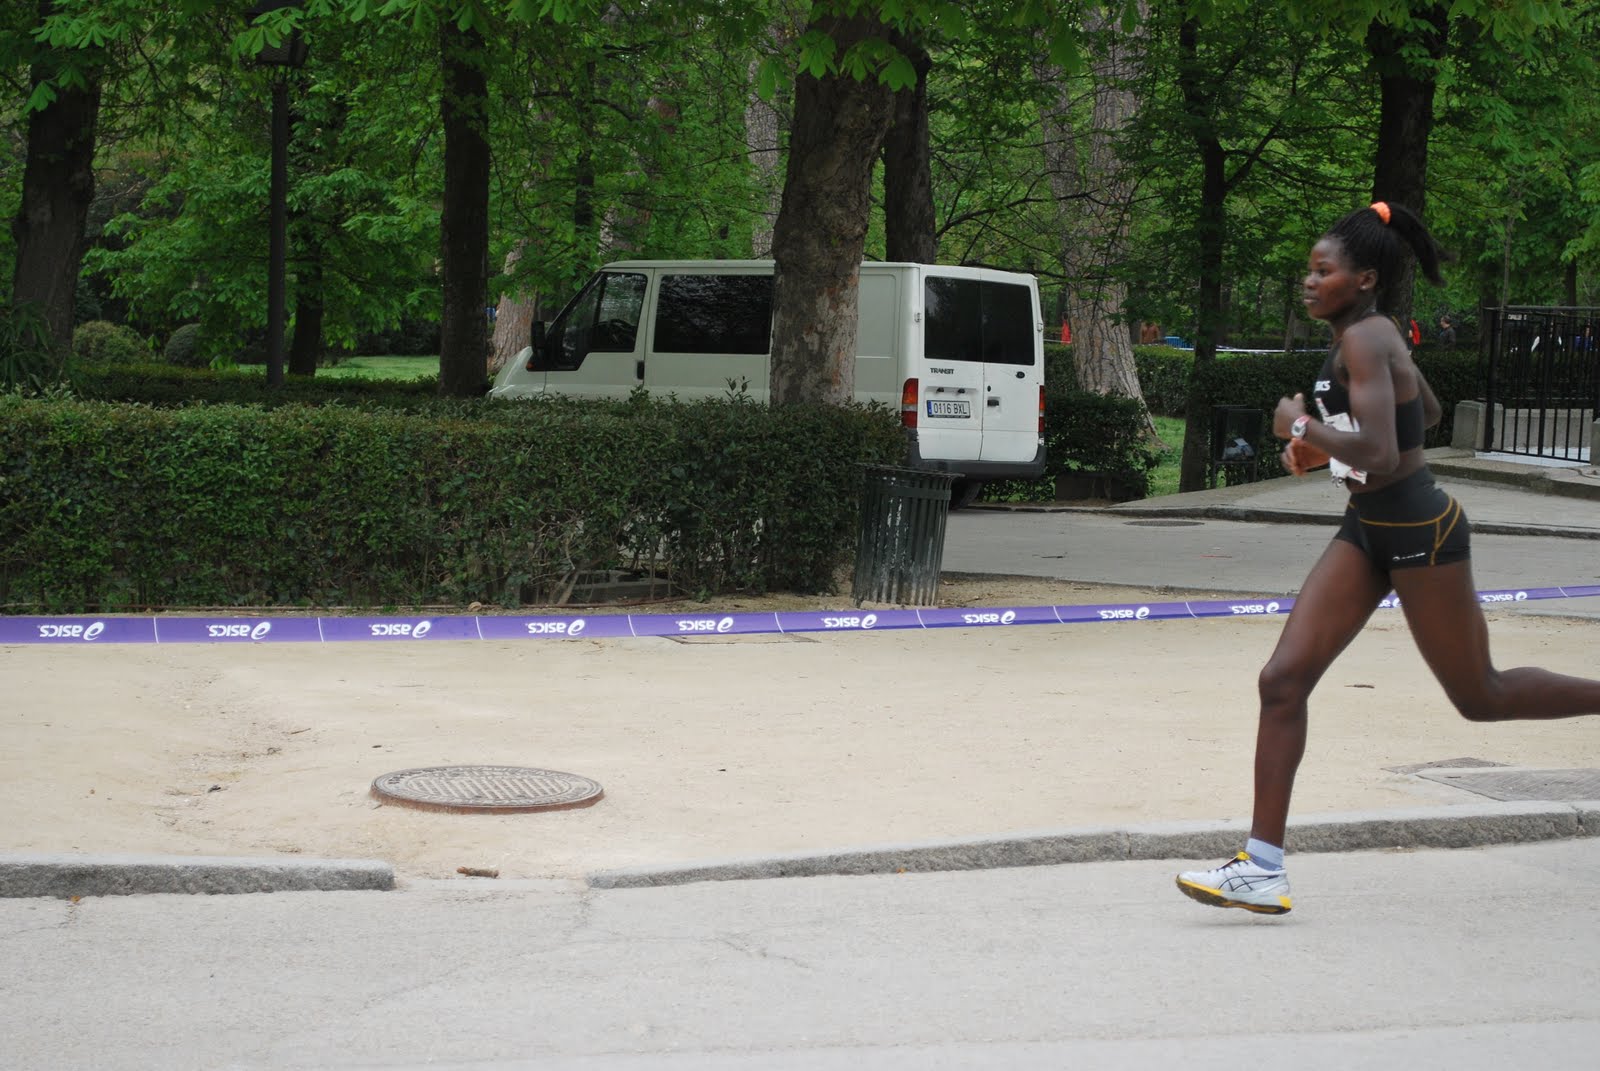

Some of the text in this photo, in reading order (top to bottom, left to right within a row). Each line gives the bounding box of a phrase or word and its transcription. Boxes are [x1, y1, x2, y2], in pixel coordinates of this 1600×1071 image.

[930, 367, 954, 375] TRANSIT
[933, 402, 968, 415] 0116 BXL
[1100, 609, 1135, 619] asics
[1231, 604, 1265, 615] asics
[823, 617, 861, 627] asics
[964, 613, 1000, 624] asics
[39, 624, 84, 638] asics
[208, 624, 249, 637] asics
[371, 623, 412, 636] asics
[527, 622, 567, 634] asics
[678, 619, 716, 631] asics
